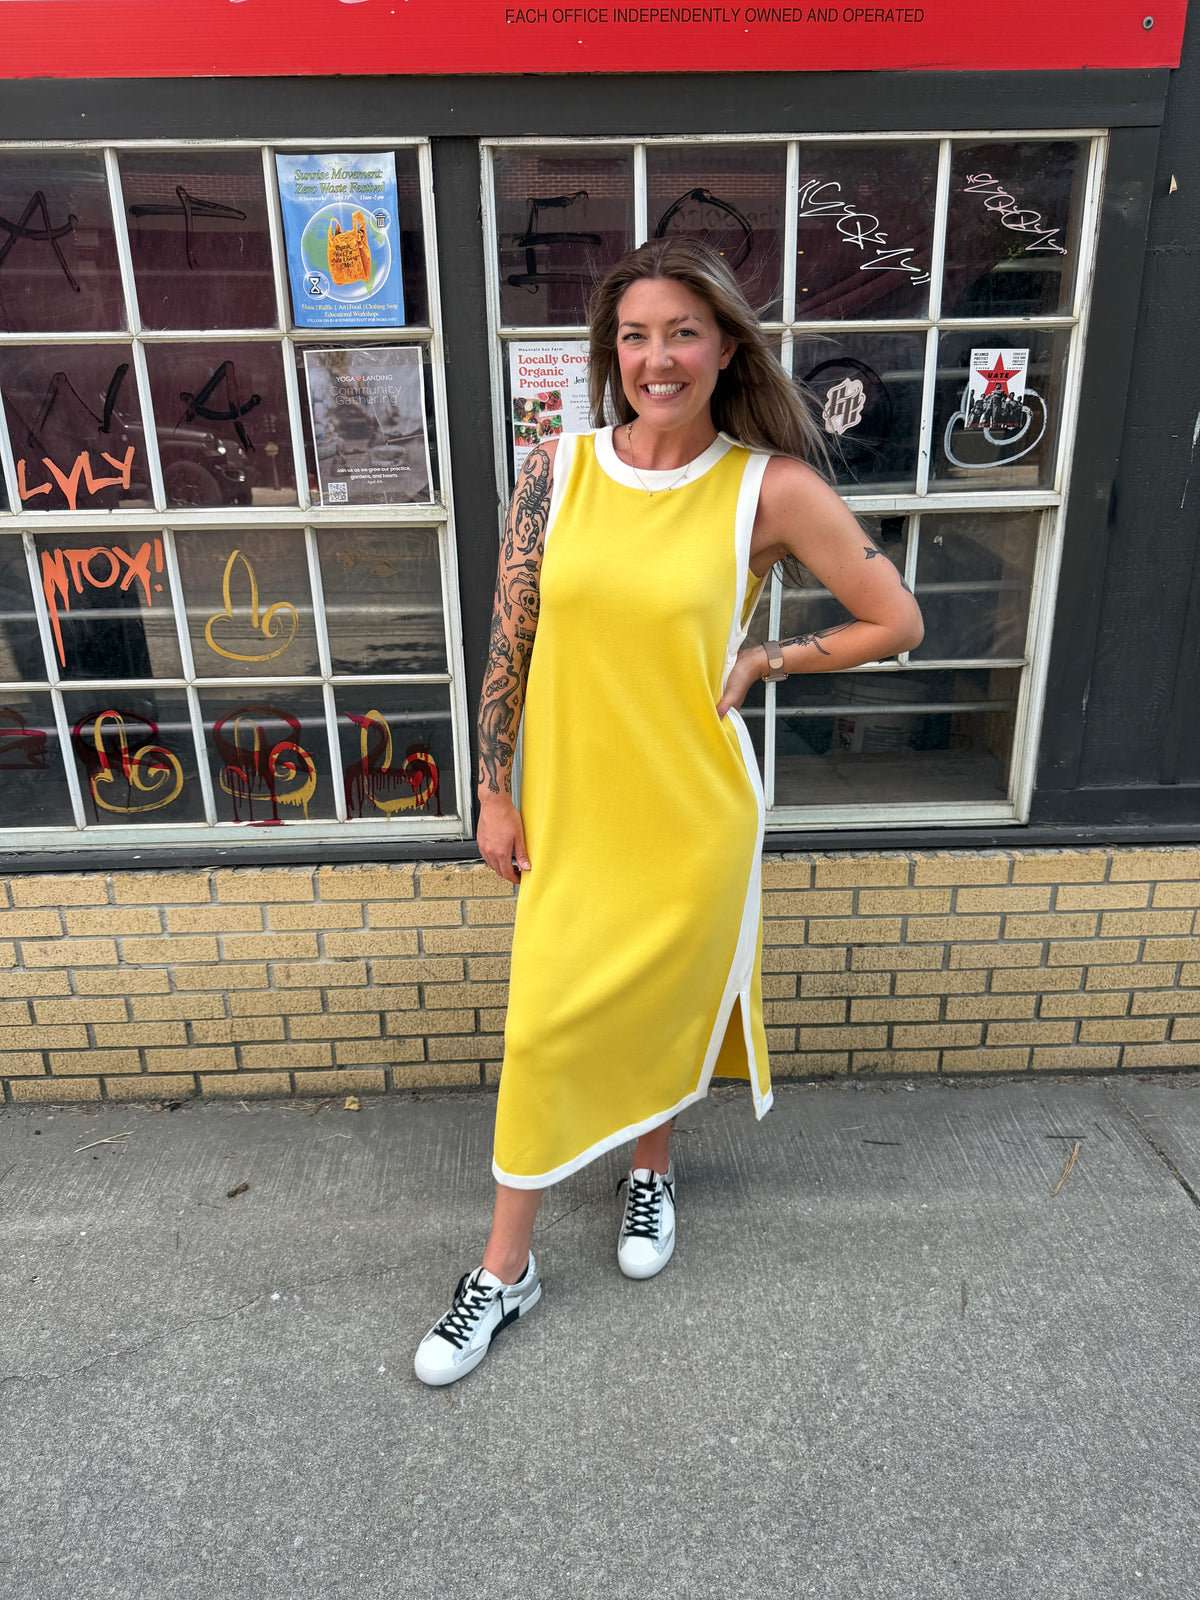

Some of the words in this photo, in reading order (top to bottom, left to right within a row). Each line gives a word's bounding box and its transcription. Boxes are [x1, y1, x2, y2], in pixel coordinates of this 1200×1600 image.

[505, 9, 547, 23] EACH
[552, 8, 608, 23] OFFICE
[613, 8, 740, 23] INDEPENDENTLY
[744, 8, 802, 22] OWNED
[807, 8, 838, 22] AND
[842, 8, 924, 23] OPERATED
[294, 169, 330, 181] Sunrise
[294, 182, 318, 194] Zero
[319, 182, 347, 194] Waste
[349, 181, 385, 193] Festival
[518, 354, 558, 366] Locally
[362, 374, 393, 382] LANDING
[519, 366, 564, 378] Organic
[519, 378, 569, 388] Produce!
[329, 385, 402, 396] Community
[335, 395, 398, 406] Gathering
